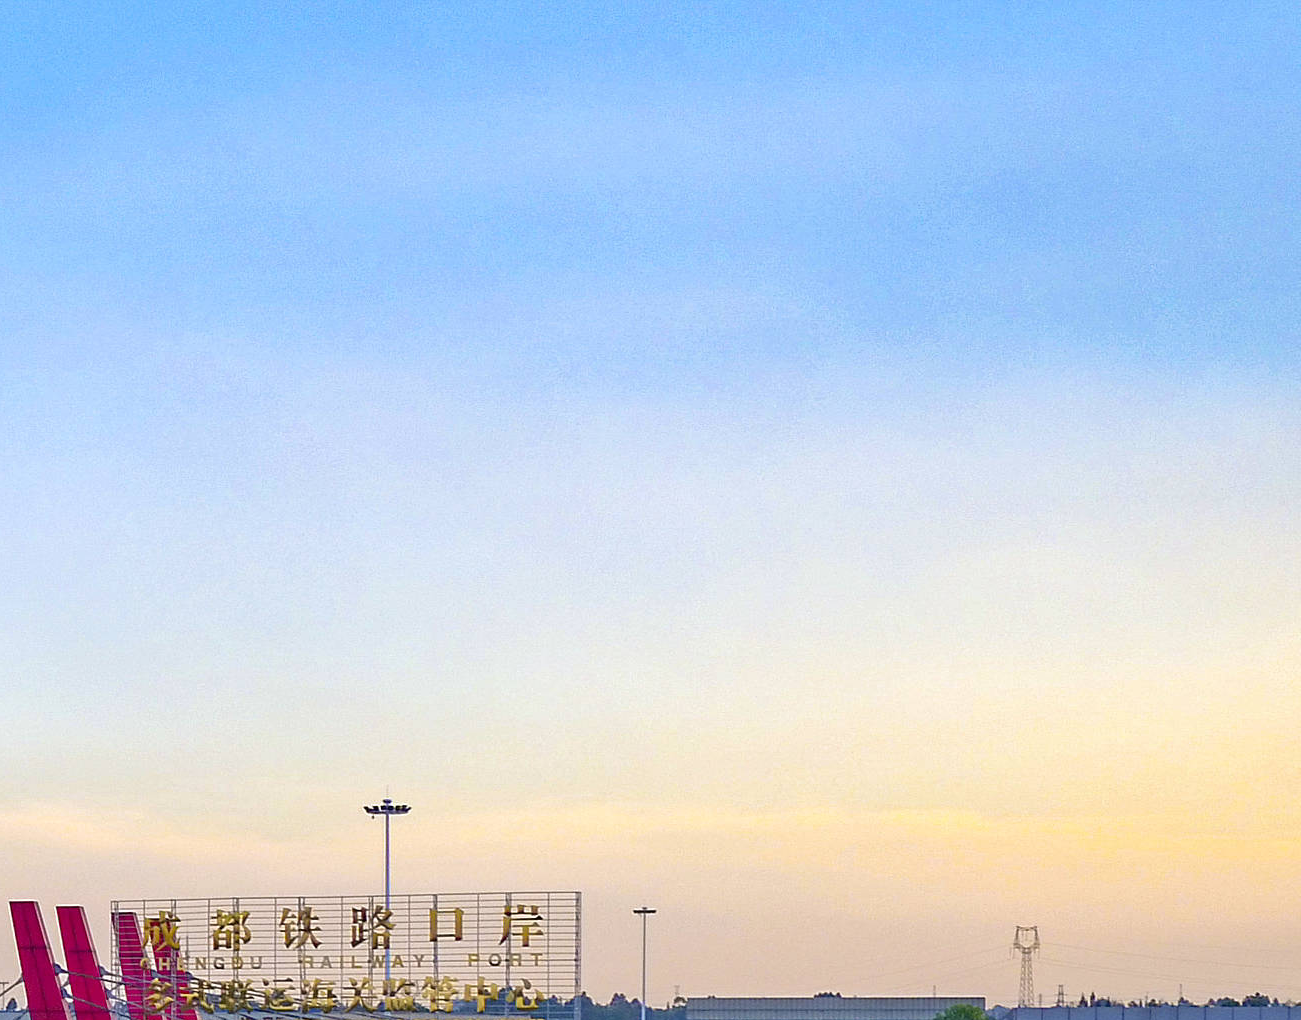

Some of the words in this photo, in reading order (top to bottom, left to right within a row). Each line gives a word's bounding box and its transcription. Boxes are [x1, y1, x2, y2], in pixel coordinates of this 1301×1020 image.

[142, 903, 544, 951] 成都铁路口岸
[140, 955, 264, 972] CHENGDU
[302, 954, 426, 970] RAILWAY
[469, 952, 544, 967] PORT
[143, 976, 544, 1013] 多式联运海关监管中心
